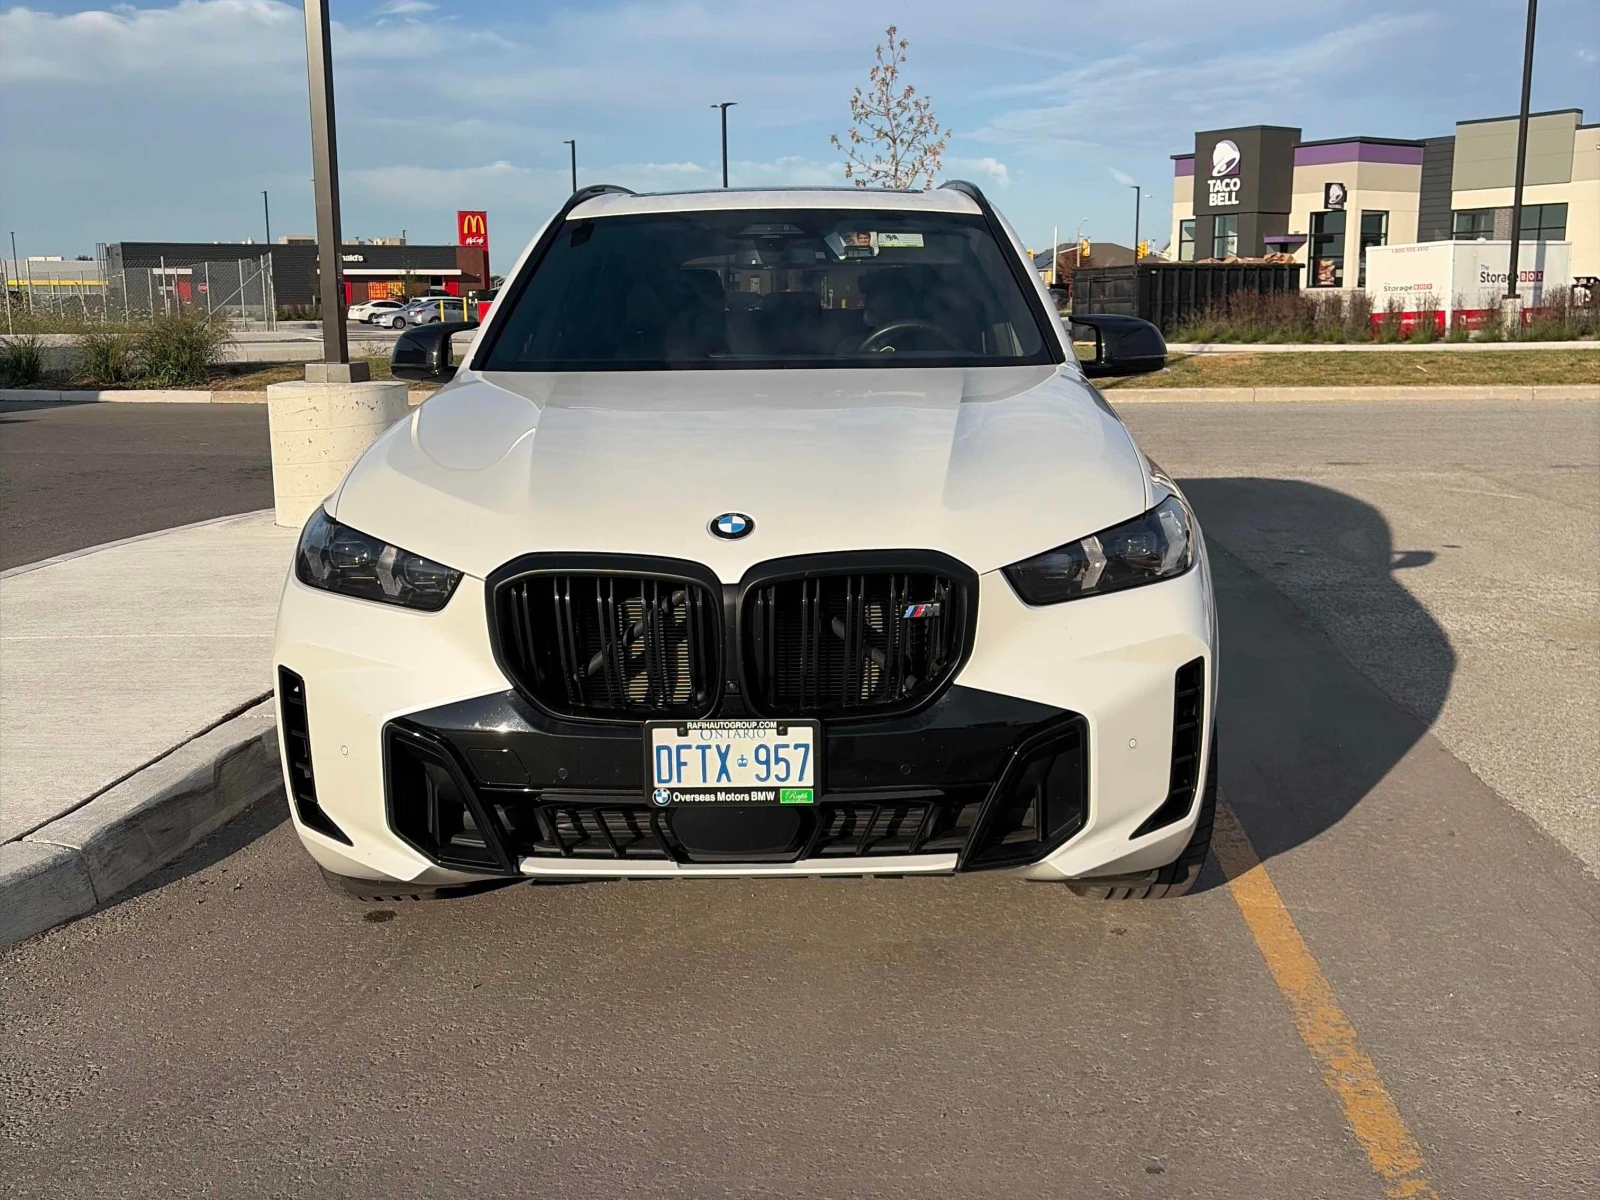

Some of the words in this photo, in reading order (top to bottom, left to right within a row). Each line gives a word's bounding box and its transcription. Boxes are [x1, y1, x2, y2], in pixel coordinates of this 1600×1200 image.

[1207, 177, 1241, 193] TACO
[1208, 191, 1240, 206] BELL
[686, 721, 777, 730] RAFIHAUTOGROUP.COM
[700, 729, 767, 741] ONTARIO
[655, 743, 732, 784] DFTX
[753, 743, 810, 783] 957
[672, 791, 716, 802] Overseas
[717, 791, 749, 802] Motors
[751, 790, 776, 801] BMW
